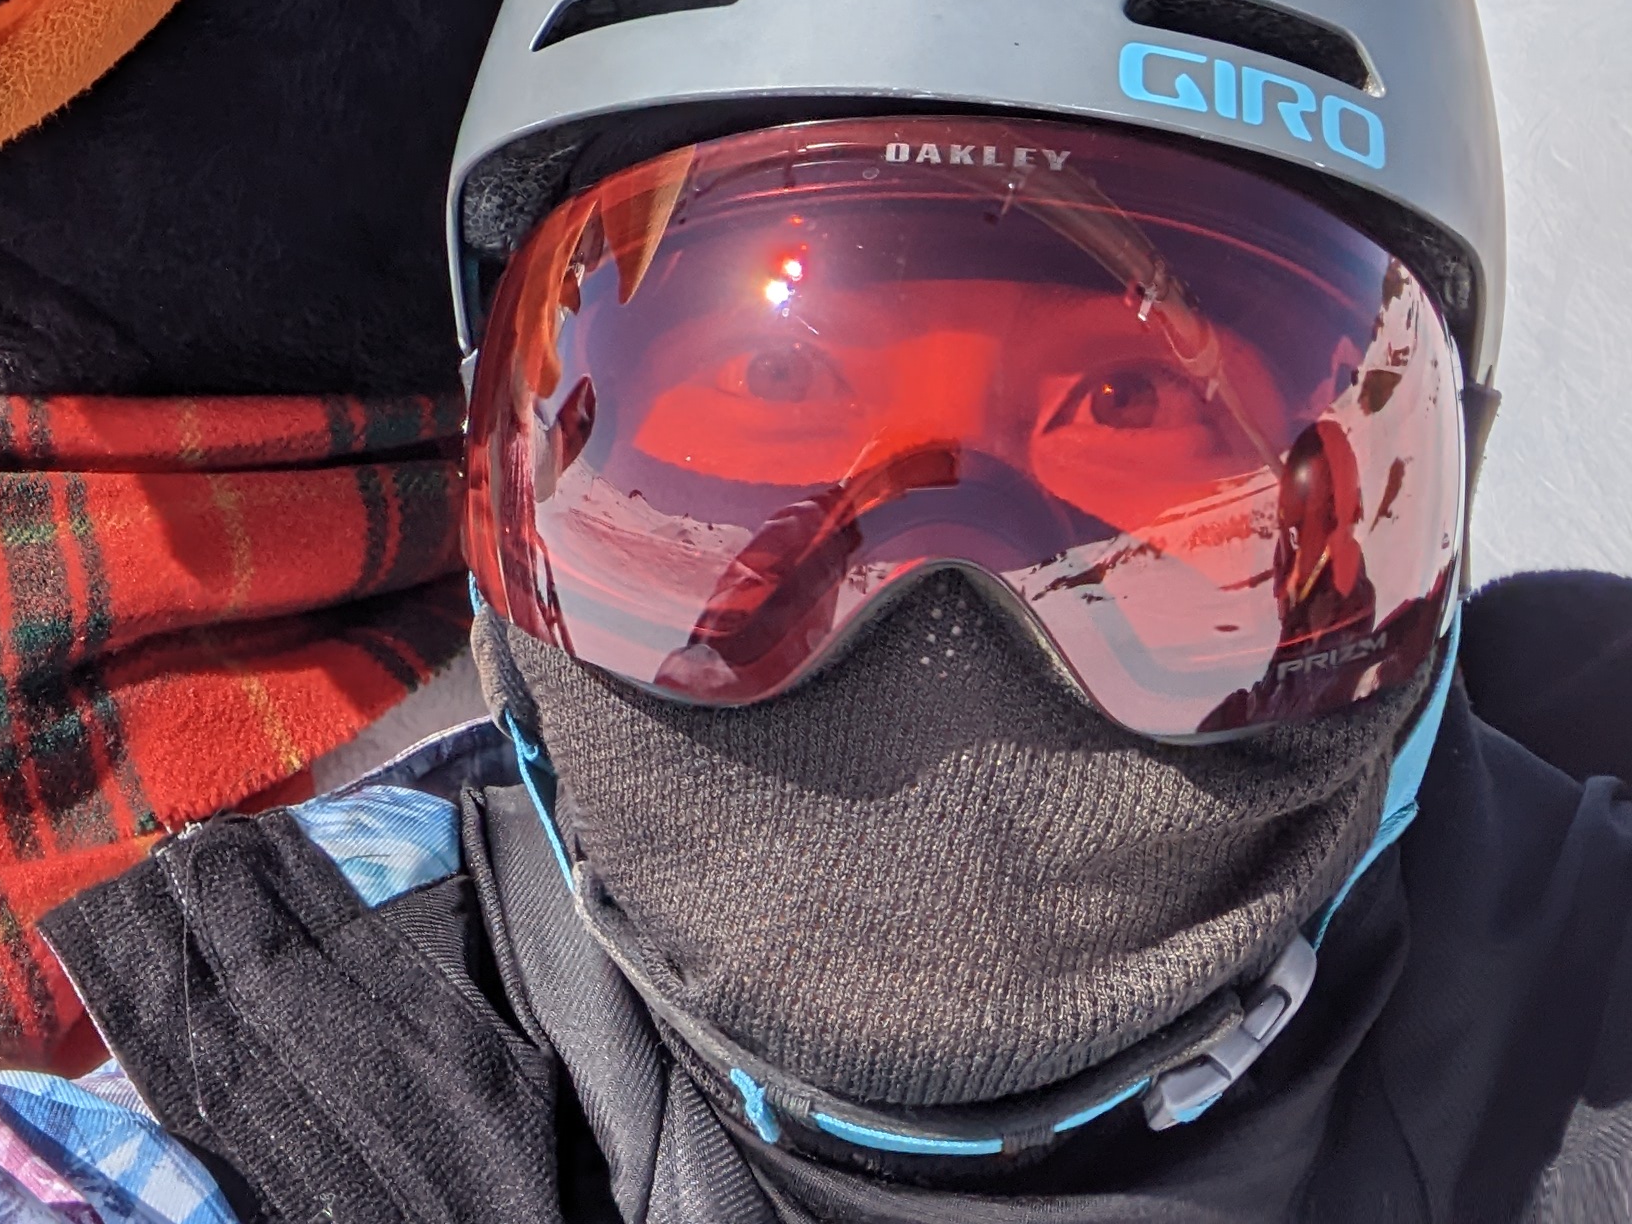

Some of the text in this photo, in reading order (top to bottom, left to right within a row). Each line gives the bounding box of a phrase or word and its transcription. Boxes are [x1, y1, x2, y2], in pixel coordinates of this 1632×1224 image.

[1119, 42, 1386, 169] GIRO
[885, 142, 1071, 172] OAKLEY
[1276, 631, 1388, 681] PRIZM
